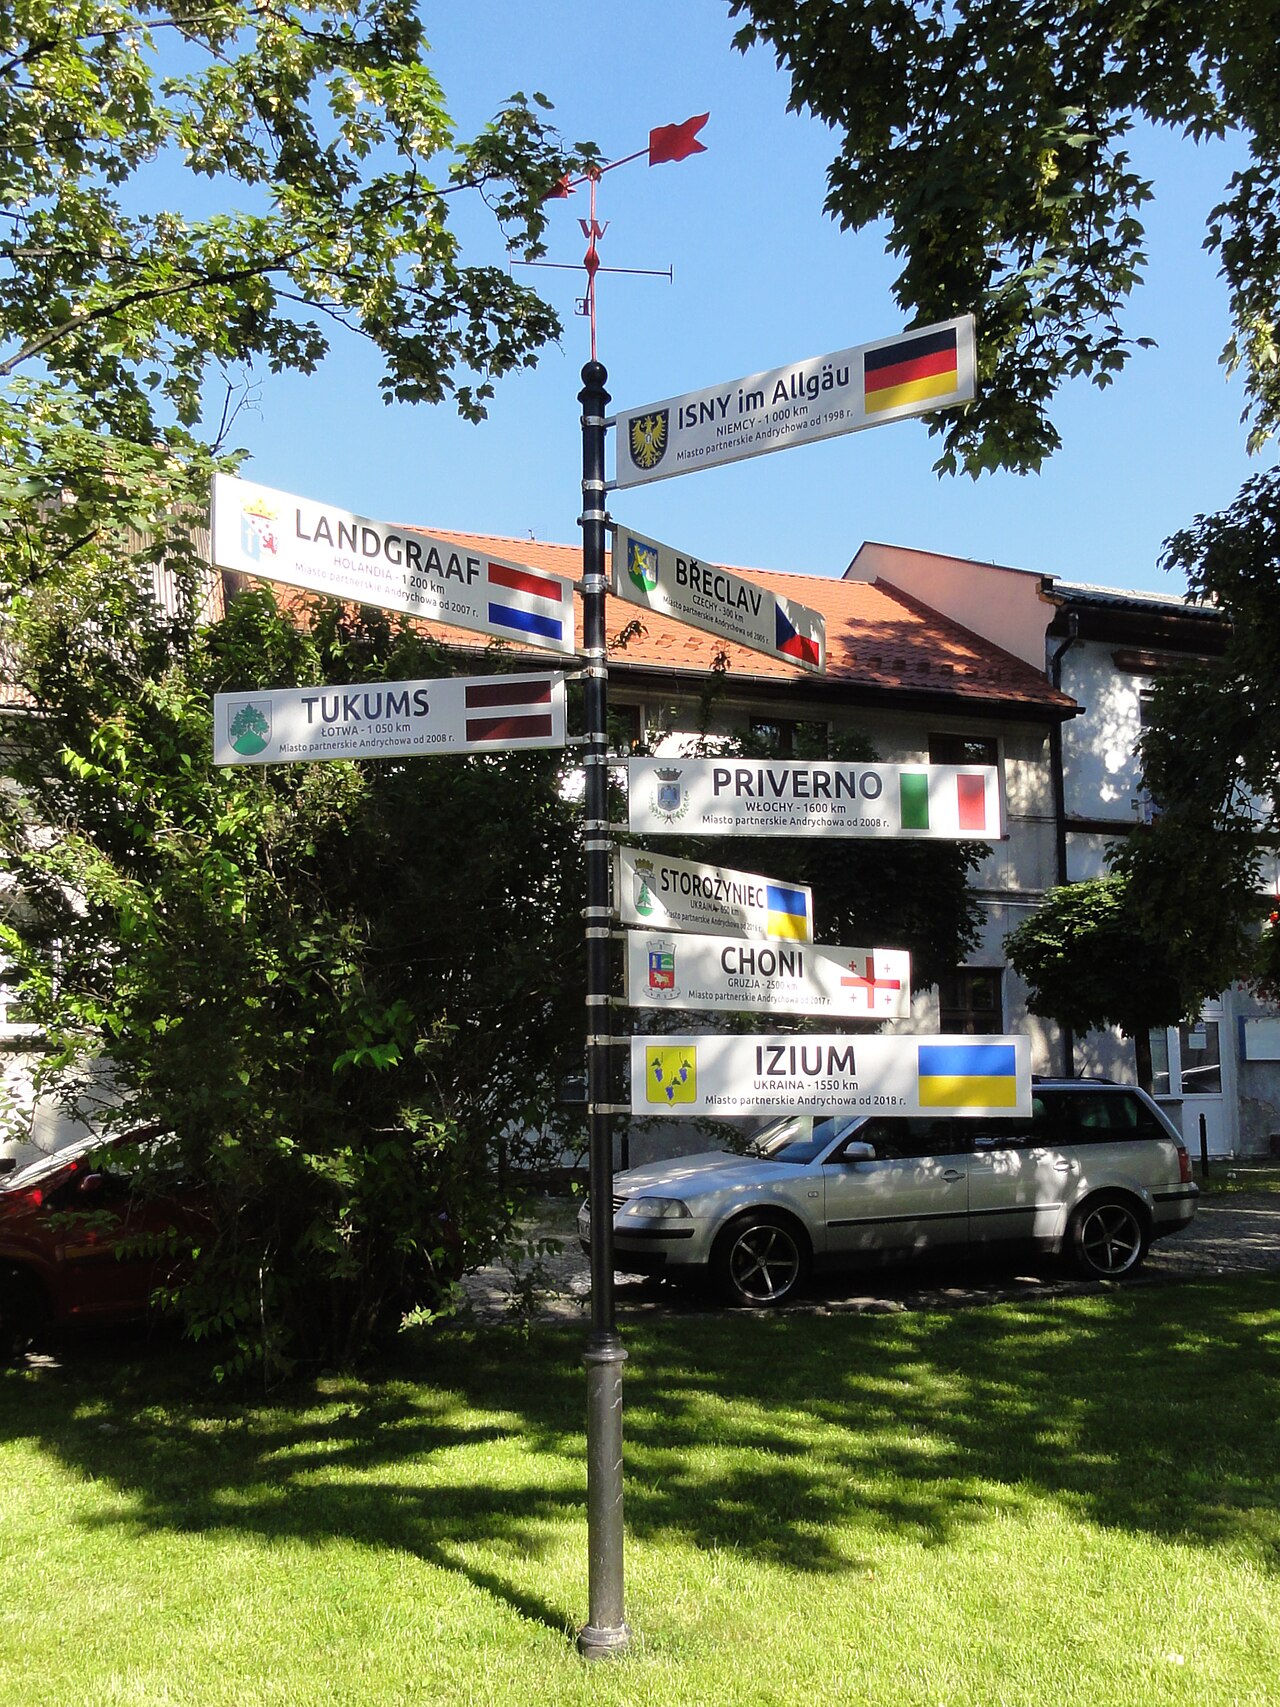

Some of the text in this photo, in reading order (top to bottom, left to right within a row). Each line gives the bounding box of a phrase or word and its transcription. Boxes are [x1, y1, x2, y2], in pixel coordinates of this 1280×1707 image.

[679, 364, 849, 430] ISNY im Allgäu
[676, 448, 704, 460] Miasto
[706, 434, 754, 456] partnerskie
[755, 420, 808, 440] Andrychowa
[810, 415, 821, 426] od
[824, 410, 844, 423] 1998
[716, 418, 756, 437] NIEMCY
[764, 414, 768, 424] 1
[772, 408, 790, 422] 000
[793, 406, 808, 417] km
[296, 508, 480, 585] LANDGRAAF
[296, 562, 478, 618] Miasto partnerskie Andrychowa od 2007 r.
[334, 556, 392, 580] HOLANDIA
[402, 574, 406, 584] 1
[410, 576, 428, 590] 200
[430, 580, 444, 594] km
[676, 558, 762, 616] BŘECLAV
[683, 605, 714, 622] partnerskie
[715, 616, 746, 636] Andrychowa
[692, 594, 718, 612] CZECHY
[722, 606, 733, 619] 300
[734, 610, 744, 623] km
[301, 689, 430, 724] TUKUMS
[279, 744, 308, 752] Miasto
[310, 740, 358, 752] partnerskie
[360, 737, 411, 748] Andrychowa
[414, 735, 424, 744] od
[426, 734, 447, 744] 2008
[321, 726, 358, 737] ŁOTWA
[368, 725, 372, 734] 1
[376, 724, 393, 734] 050
[396, 722, 410, 732] km
[713, 768, 882, 800] PRIVERNO
[702, 815, 733, 824] Miasto
[735, 816, 787, 826] partnerskie
[790, 817, 844, 828] Andrychowa
[847, 818, 858, 827] od
[860, 818, 881, 827] 2008
[746, 802, 794, 812] WŁOCHY
[804, 803, 828, 813] 1600
[831, 802, 846, 813] km
[661, 868, 764, 908] STOROŻYNIEC
[690, 900, 717, 912] UKRAINA
[720, 946, 803, 978] CHONI
[688, 990, 713, 1000] Miasto
[715, 992, 756, 1001] partnerskie
[728, 978, 760, 988] GRUZJA
[766, 980, 785, 990] 2500
[756, 1046, 856, 1076] IZIUM
[753, 1080, 805, 1090] UKRAINA
[814, 1080, 840, 1090] 1550
[842, 1079, 859, 1090] km
[705, 1094, 738, 1104] Miasto
[740, 1095, 795, 1106] partnerskie
[797, 1095, 857, 1107] Andrychowa
[859, 1096, 871, 1105] od
[874, 1096, 897, 1105] 2018
